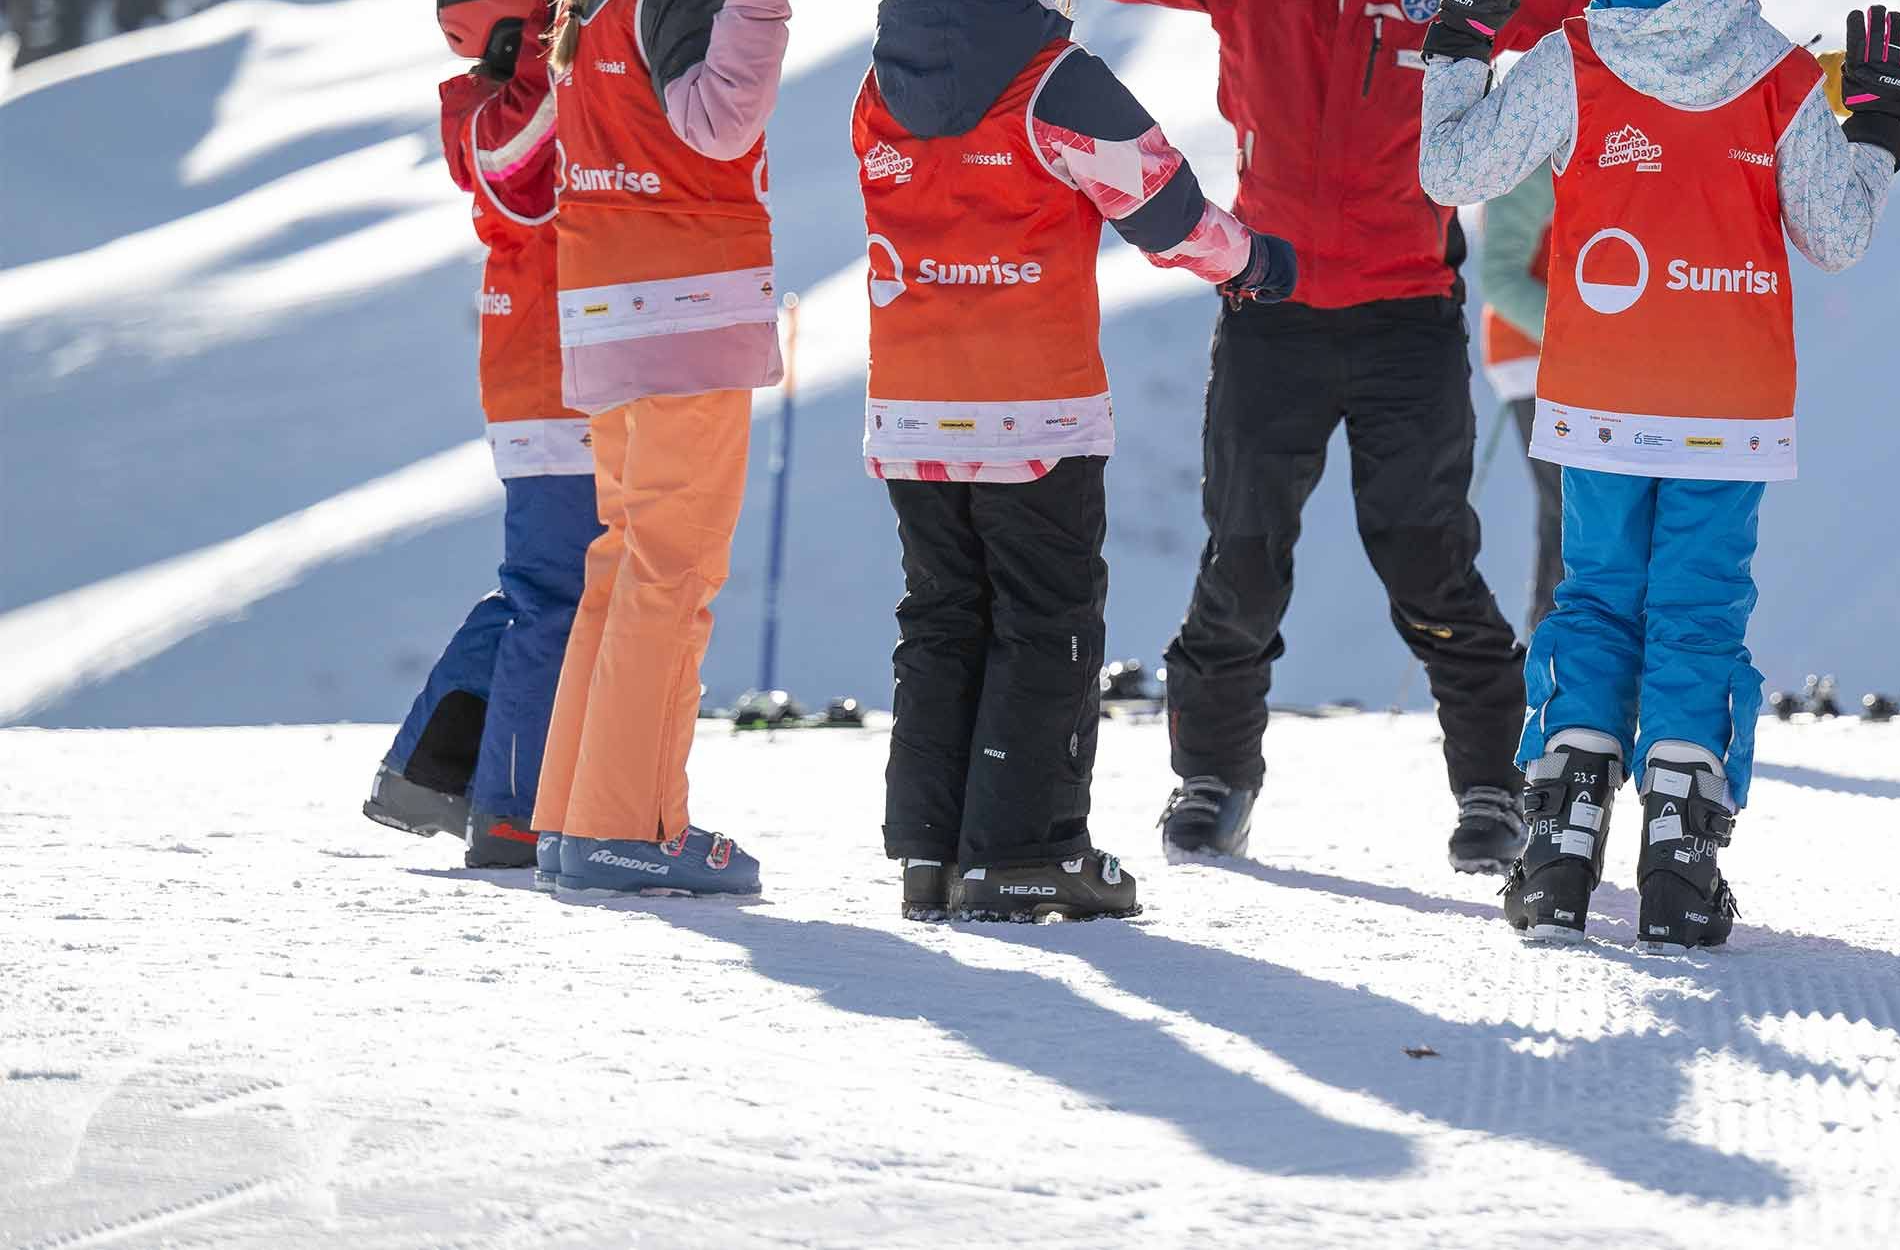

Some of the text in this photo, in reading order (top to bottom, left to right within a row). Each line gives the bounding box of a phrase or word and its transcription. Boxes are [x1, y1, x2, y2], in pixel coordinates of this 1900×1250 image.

[1600, 144, 1661, 166] Snow Days
[1607, 138, 1648, 155] Sunrise
[1727, 147, 1774, 167] swissski
[571, 162, 662, 194] Sunrise
[915, 256, 1042, 286] Sunrise
[1573, 772, 1598, 785] 23.5
[1531, 818, 1560, 837] UBE
[1681, 834, 1719, 858] CUB
[588, 849, 671, 876] NORDICA
[999, 885, 1057, 896] HEAD
[1523, 890, 1545, 906] HEAD
[1684, 910, 1709, 925] HEAD
